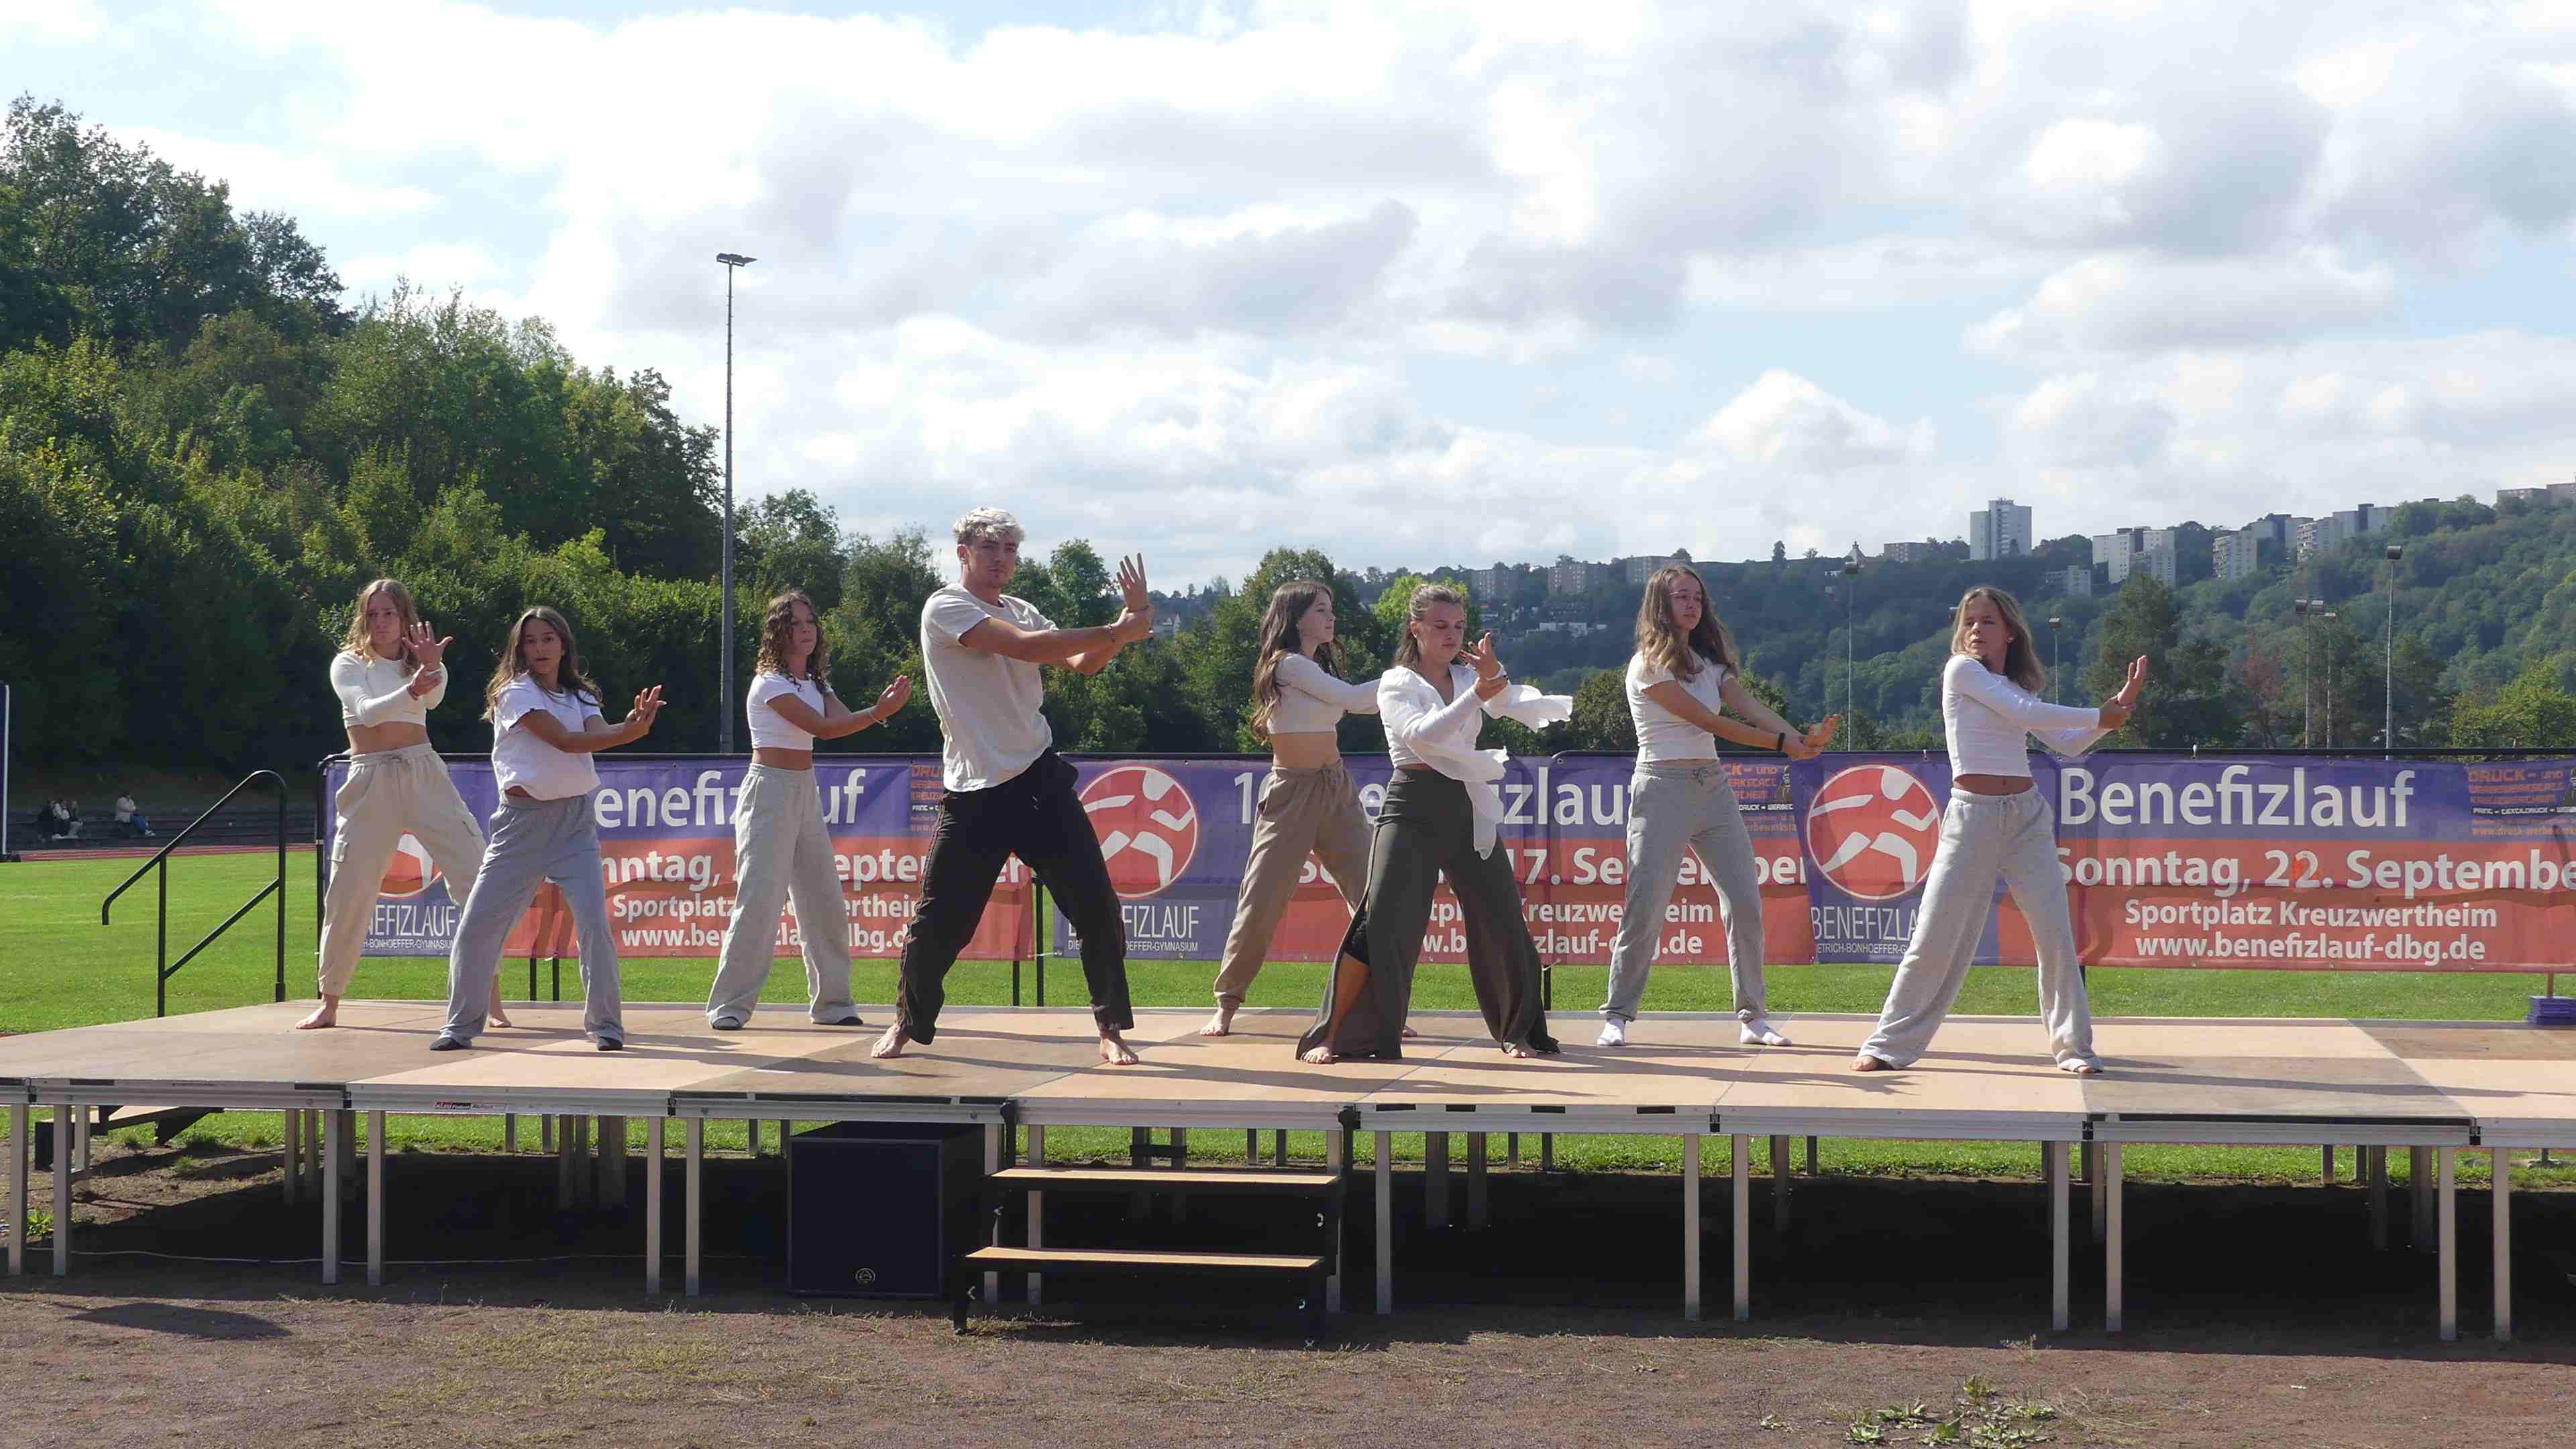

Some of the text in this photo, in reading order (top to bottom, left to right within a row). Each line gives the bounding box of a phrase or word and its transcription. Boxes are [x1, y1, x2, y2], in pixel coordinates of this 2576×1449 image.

[594, 768, 866, 827] enefiuf
[2059, 765, 2416, 827] Benefizlauf
[601, 851, 720, 892] nntag,
[2264, 849, 2333, 889] 22.
[2347, 848, 2576, 900] Septembe
[369, 905, 456, 937] EFIZLAUF
[1811, 906, 1919, 941] BENEFIZLA
[2125, 900, 2497, 930] Sportplatz Kreuzwertheim
[1817, 943, 1909, 954] ETRICH-BONHOEFFER-G
[2135, 931, 2485, 966] www.benefizlauf-dbg.de
